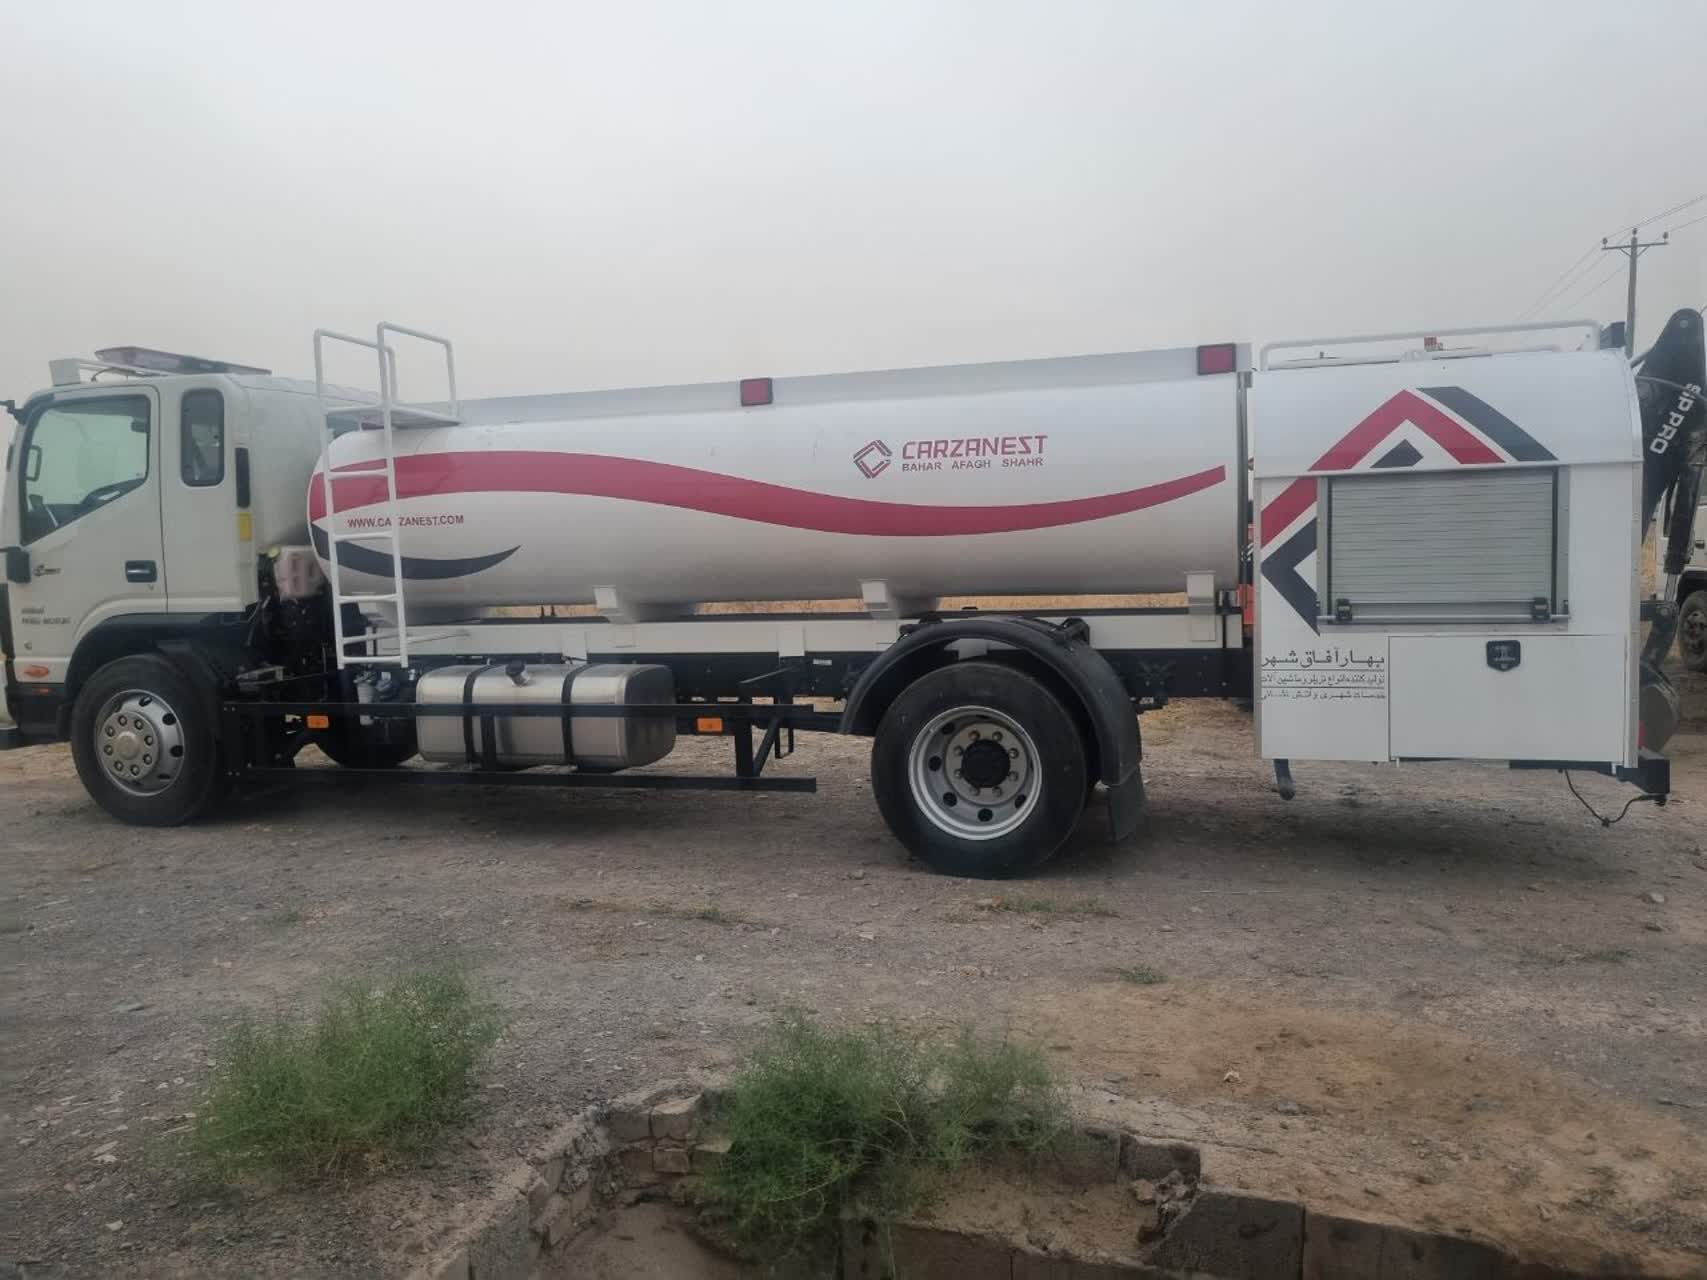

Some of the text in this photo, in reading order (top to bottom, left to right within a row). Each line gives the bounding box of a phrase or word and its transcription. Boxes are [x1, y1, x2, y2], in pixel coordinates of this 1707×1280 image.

[1649, 411, 1685, 454] PRO
[902, 435, 1048, 460] CARZANEST
[902, 457, 1044, 473] BAHAR AFAGH SHAHR
[347, 514, 464, 528] WWW.CAZANEST.COM
[1260, 647, 1384, 668] بهار آفاق شهر
